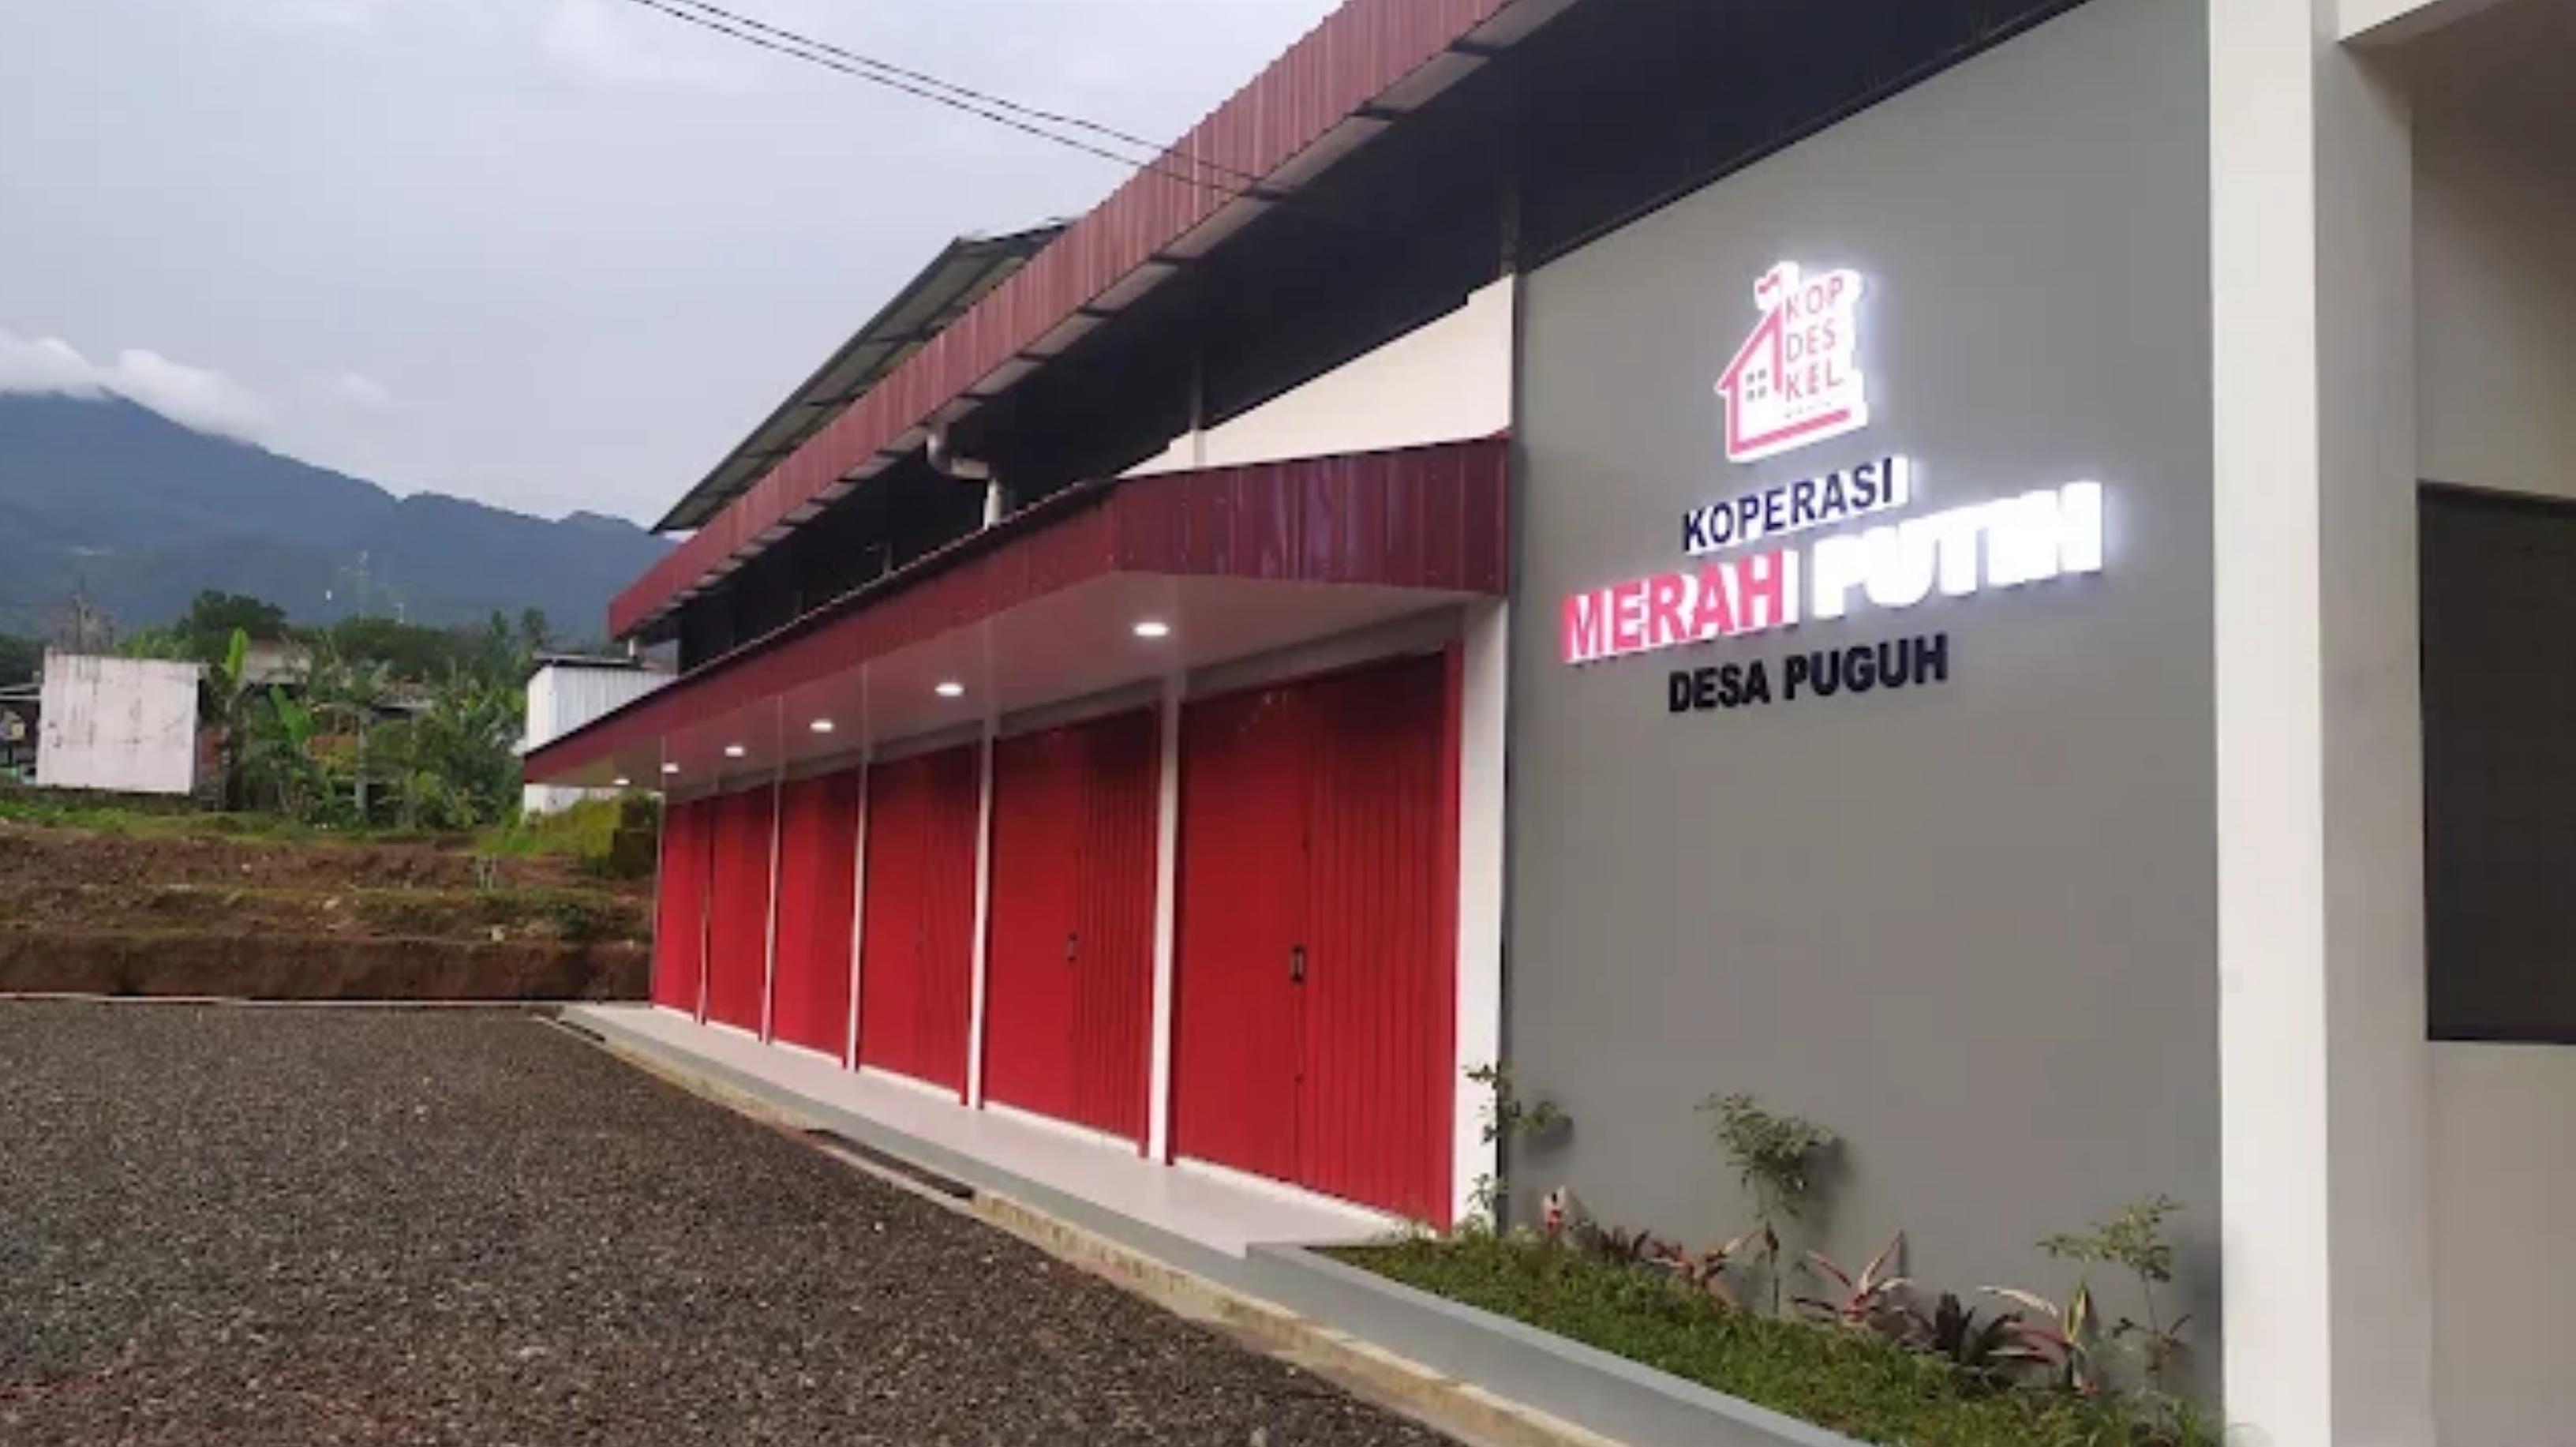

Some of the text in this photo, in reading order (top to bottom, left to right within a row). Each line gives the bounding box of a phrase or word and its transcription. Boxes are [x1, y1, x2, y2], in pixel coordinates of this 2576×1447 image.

[1786, 276, 1844, 324] KOP
[1786, 318, 1836, 362] DES
[1786, 358, 1844, 402] KEL
[1683, 456, 1896, 553] KOPERASI
[1563, 549, 1790, 662] MERAH
[1669, 633, 1948, 712] DESA PUGUH
